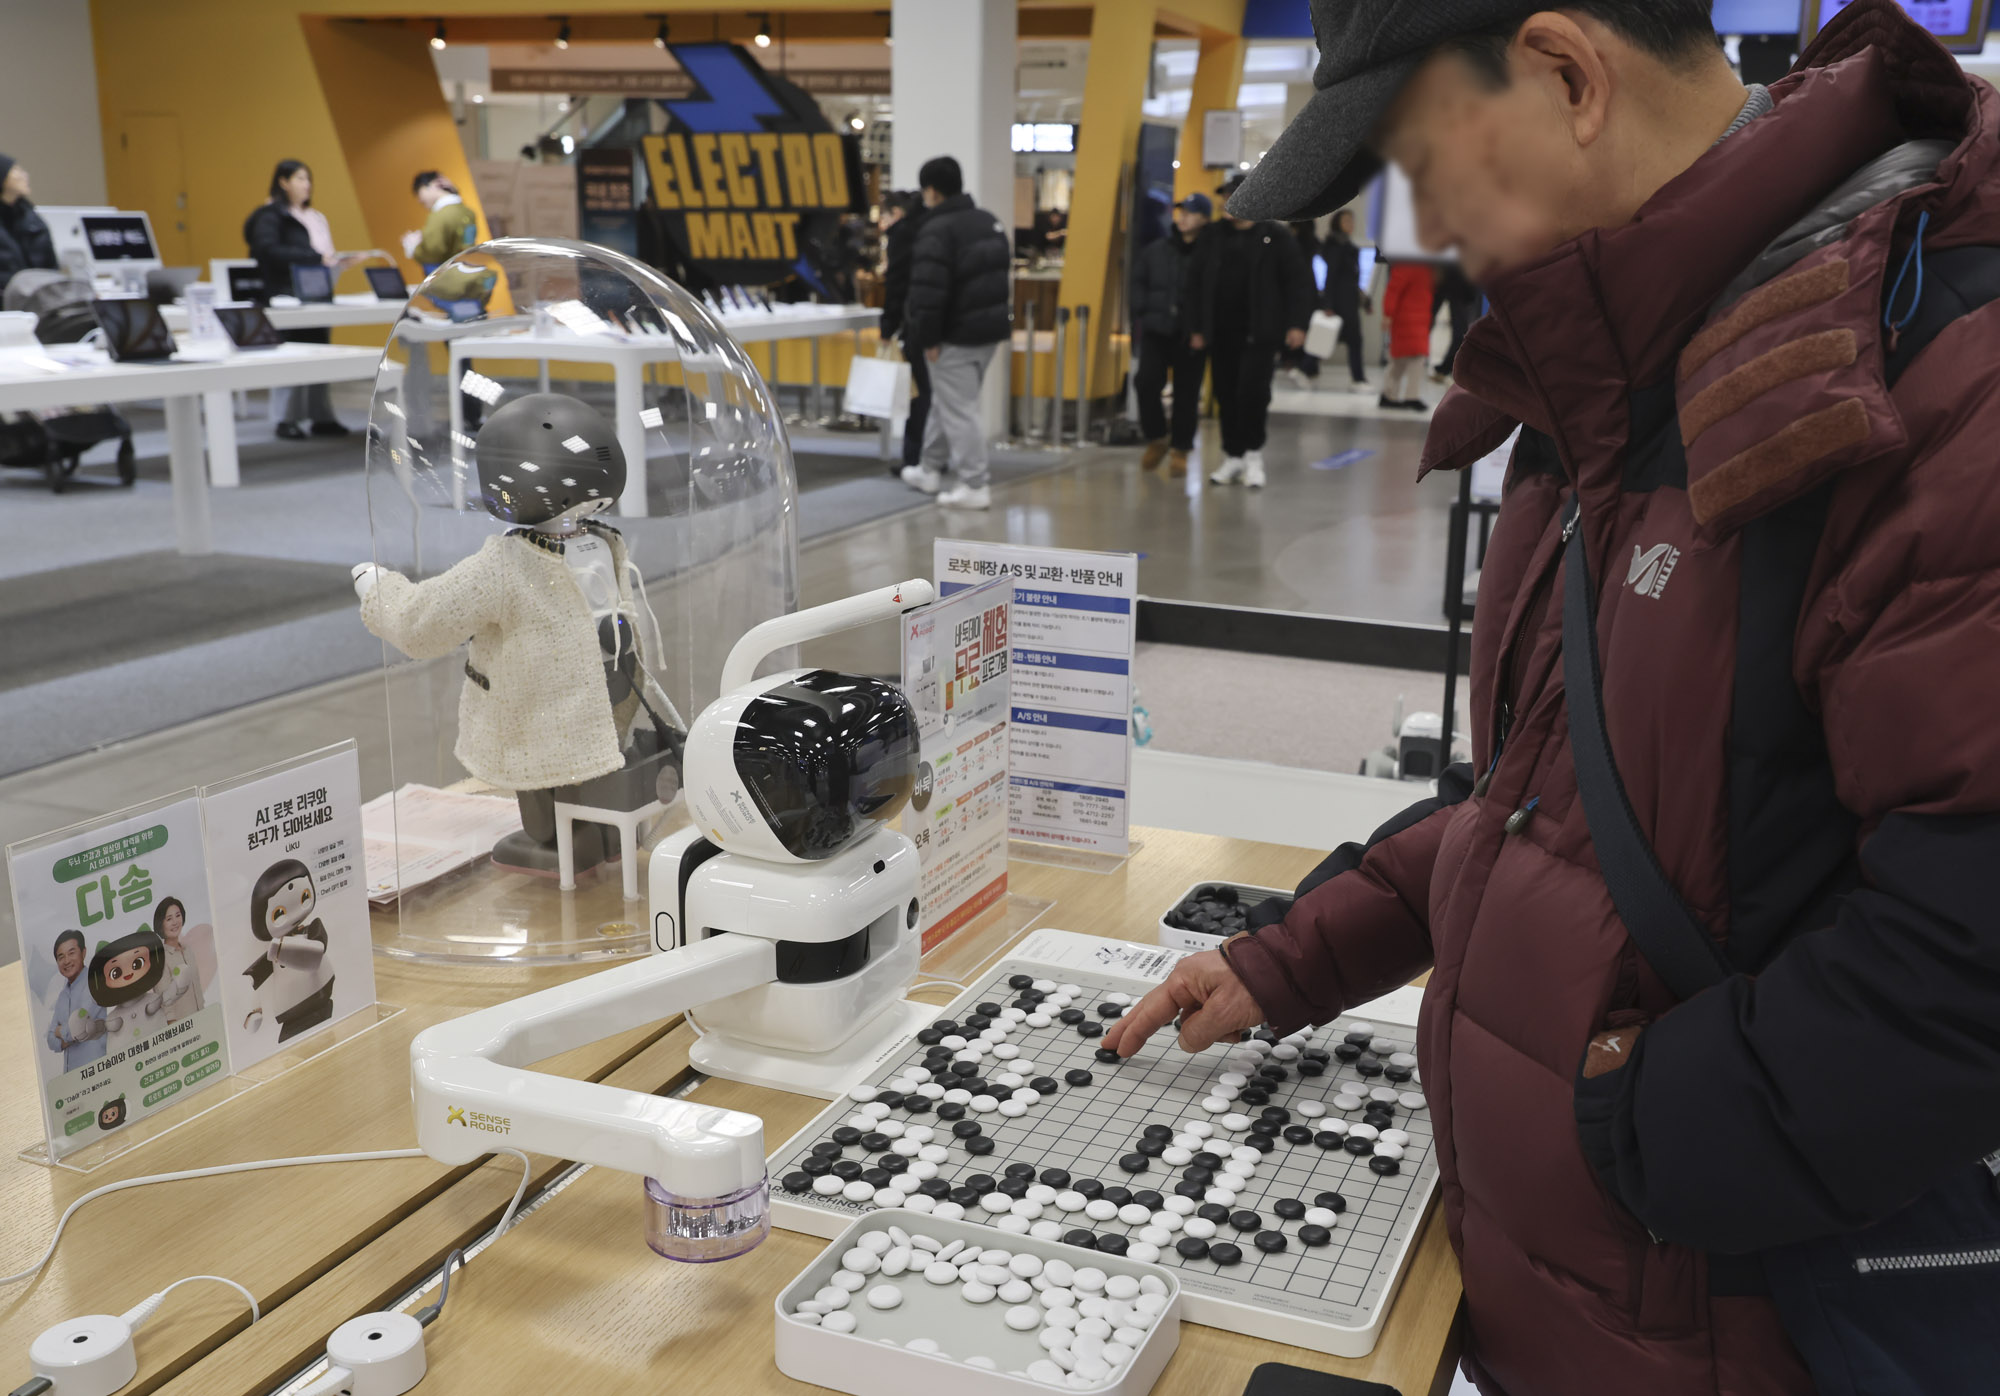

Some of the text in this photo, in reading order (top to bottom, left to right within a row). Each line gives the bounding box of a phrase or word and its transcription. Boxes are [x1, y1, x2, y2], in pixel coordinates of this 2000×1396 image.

[642, 133, 850, 209] ELECTRO
[684, 212, 800, 260] MART
[948, 558, 1123, 588] 로봇 매장 A/S 및 교환 반품 안내
[1651, 547, 1681, 600] MILLET
[1026, 593, 1041, 604] 불량
[1041, 594, 1057, 605] 안내
[954, 602, 1009, 657] 바둑데이 체험
[955, 641, 1008, 695] 무료 프로그램
[1041, 653, 1057, 665] 안내
[1017, 711, 1048, 723] A/S 안내
[913, 774, 932, 797] 바둑
[255, 787, 328, 827] AI 로봇 리쿠와
[248, 805, 333, 851] 친구가 되어보세요
[914, 828, 931, 849] 오목
[68, 856, 80, 867] 두뇌
[82, 849, 101, 862] 건강과
[102, 842, 121, 855] 일상의
[141, 830, 154, 841] 위한
[89, 847, 138, 871] AI 인지 케어 로봇
[76, 863, 153, 927] 다솜
[80, 1019, 194, 1081] 지금 다솜이와 대화를 시작해보세요!
[470, 1111, 511, 1126] SENSE
[470, 1120, 511, 1135] ROBOT
[815, 1202, 857, 1215] CULTURE
